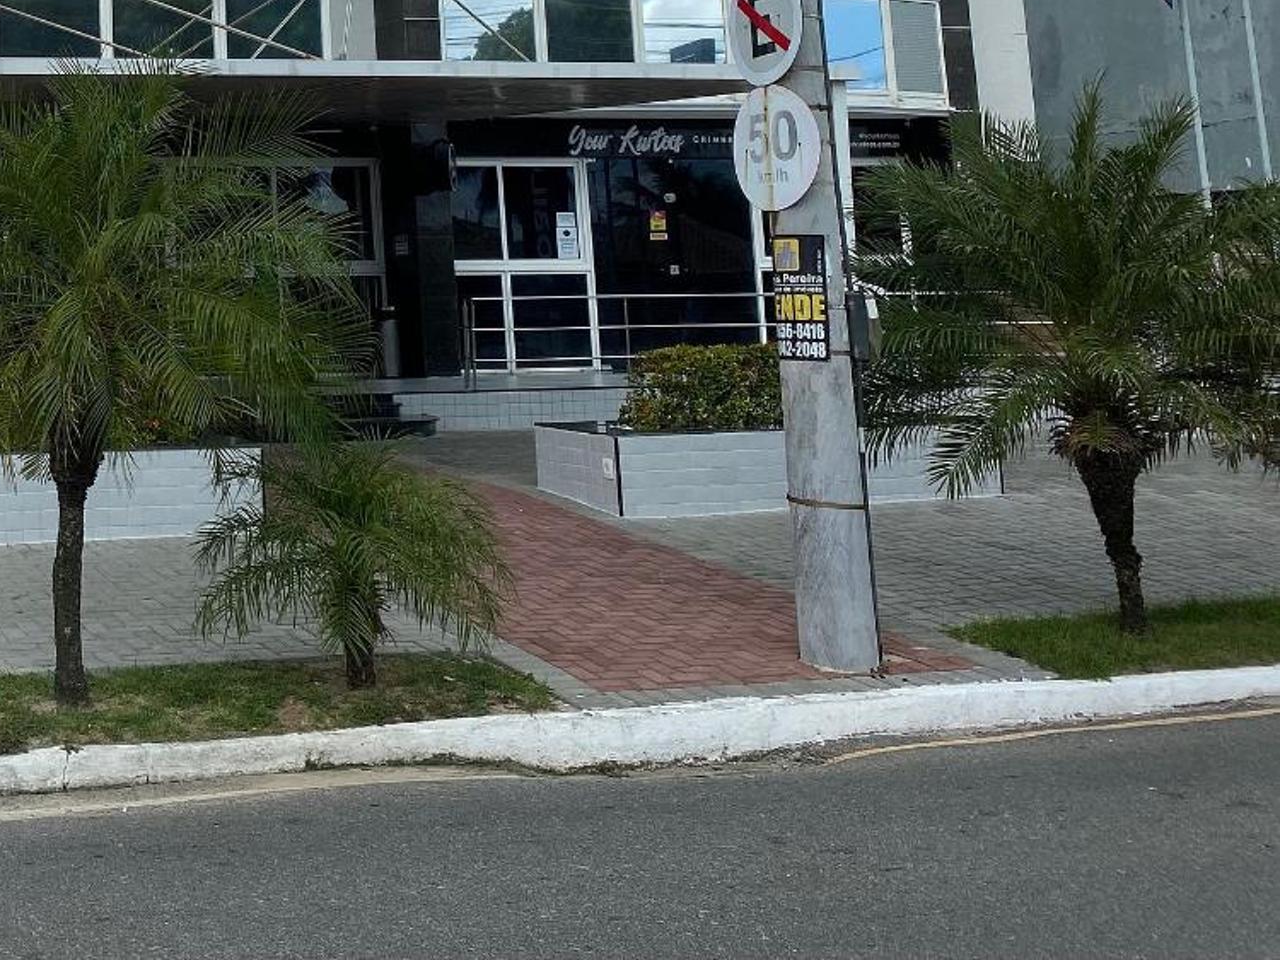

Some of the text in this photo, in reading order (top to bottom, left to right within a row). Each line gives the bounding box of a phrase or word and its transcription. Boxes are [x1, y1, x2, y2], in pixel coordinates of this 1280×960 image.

[569, 125, 612, 155] Your
[749, 110, 798, 163] 50
[782, 273, 824, 283] Pereira
[776, 293, 826, 321] ENDE
[777, 340, 827, 358] 42-2048
